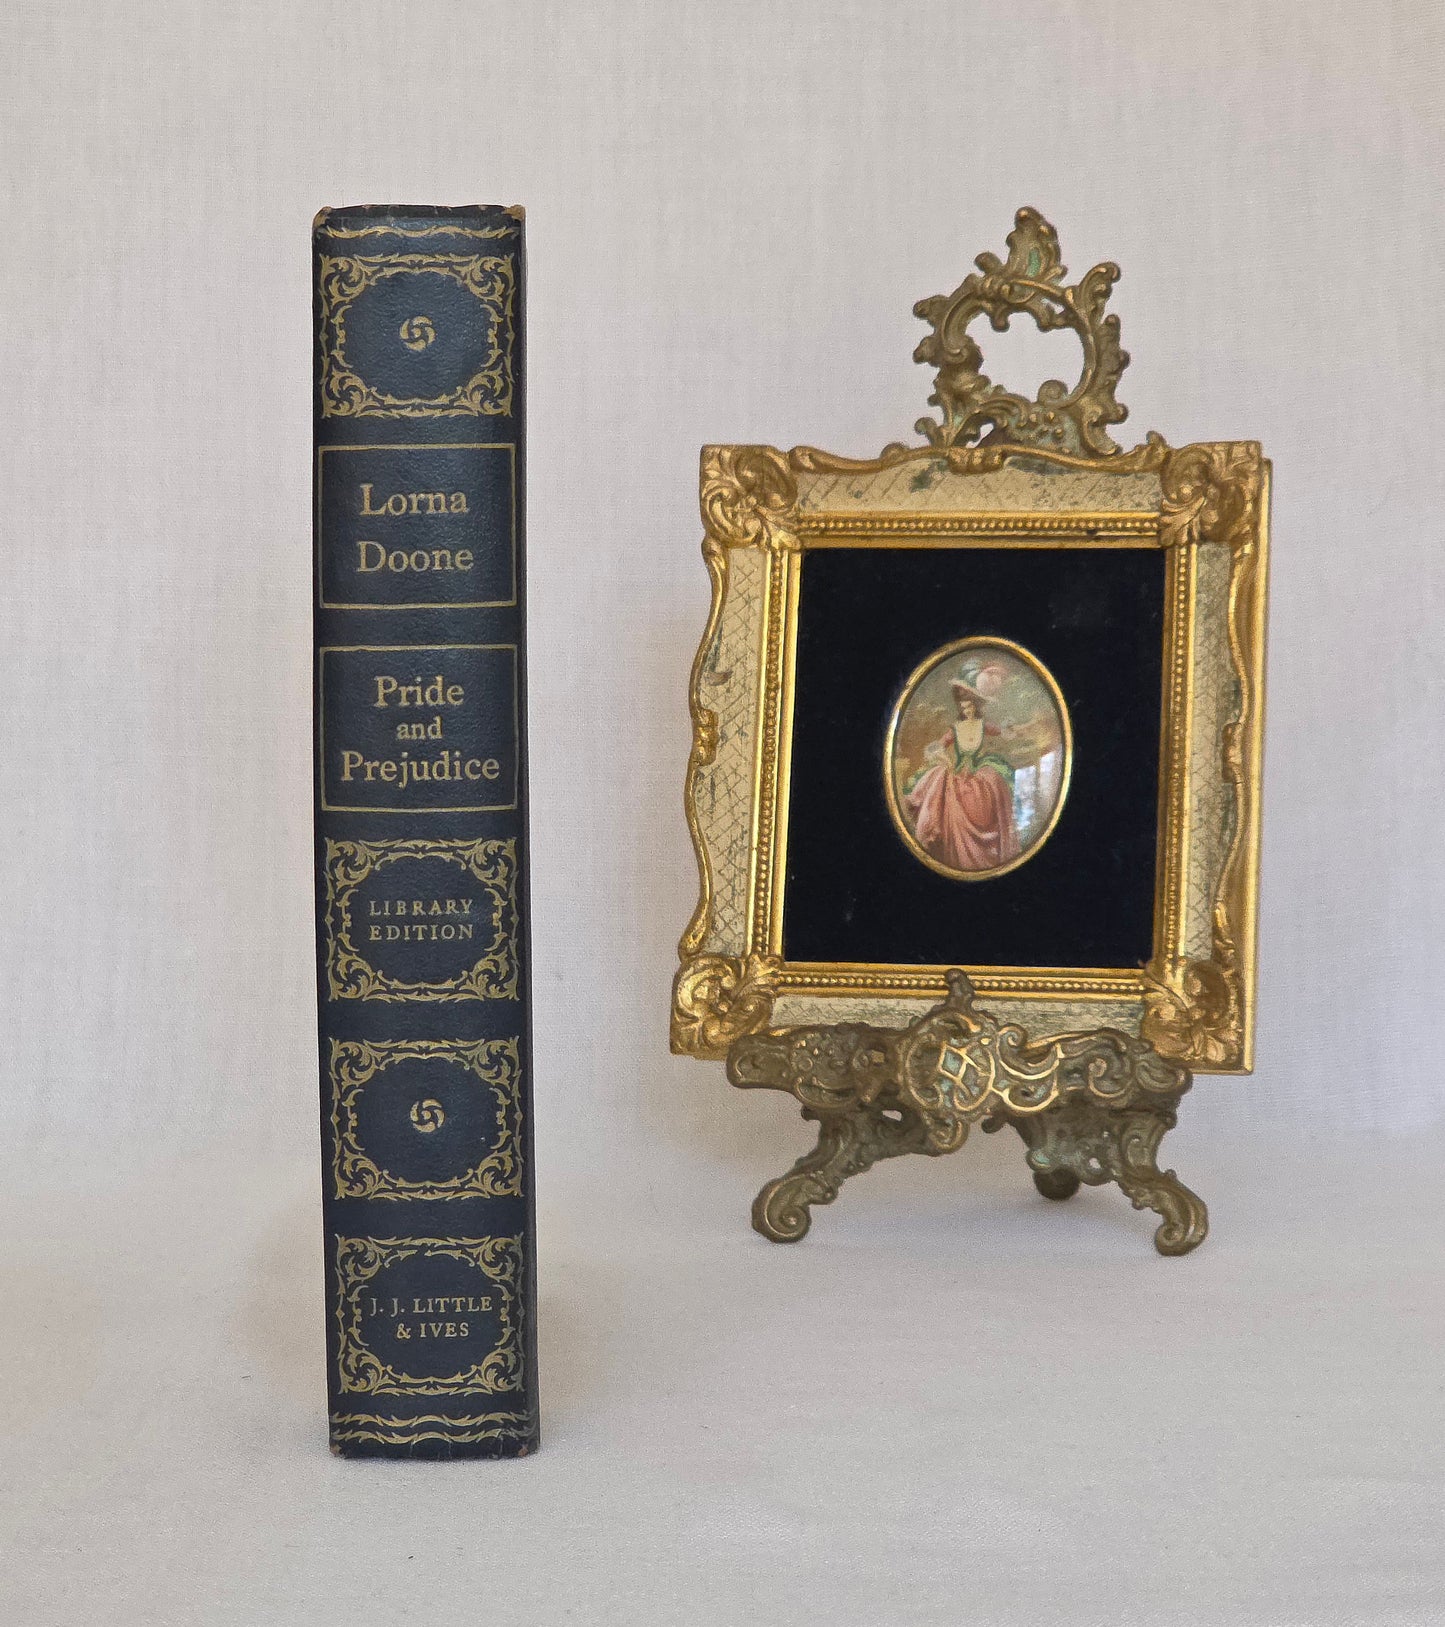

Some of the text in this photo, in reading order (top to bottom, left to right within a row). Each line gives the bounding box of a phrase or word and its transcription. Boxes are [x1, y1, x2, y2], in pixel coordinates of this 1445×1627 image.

[359, 483, 469, 516] Lorna
[356, 540, 474, 573] Doone
[373, 675, 465, 708] Pride
[396, 715, 443, 740] and
[341, 750, 500, 789] Prejudice
[369, 899, 472, 917] LIBRARY
[369, 924, 473, 941] EDITION
[370, 1296, 493, 1317] J. J. LITTLE
[396, 1322, 469, 1339] & IVES
